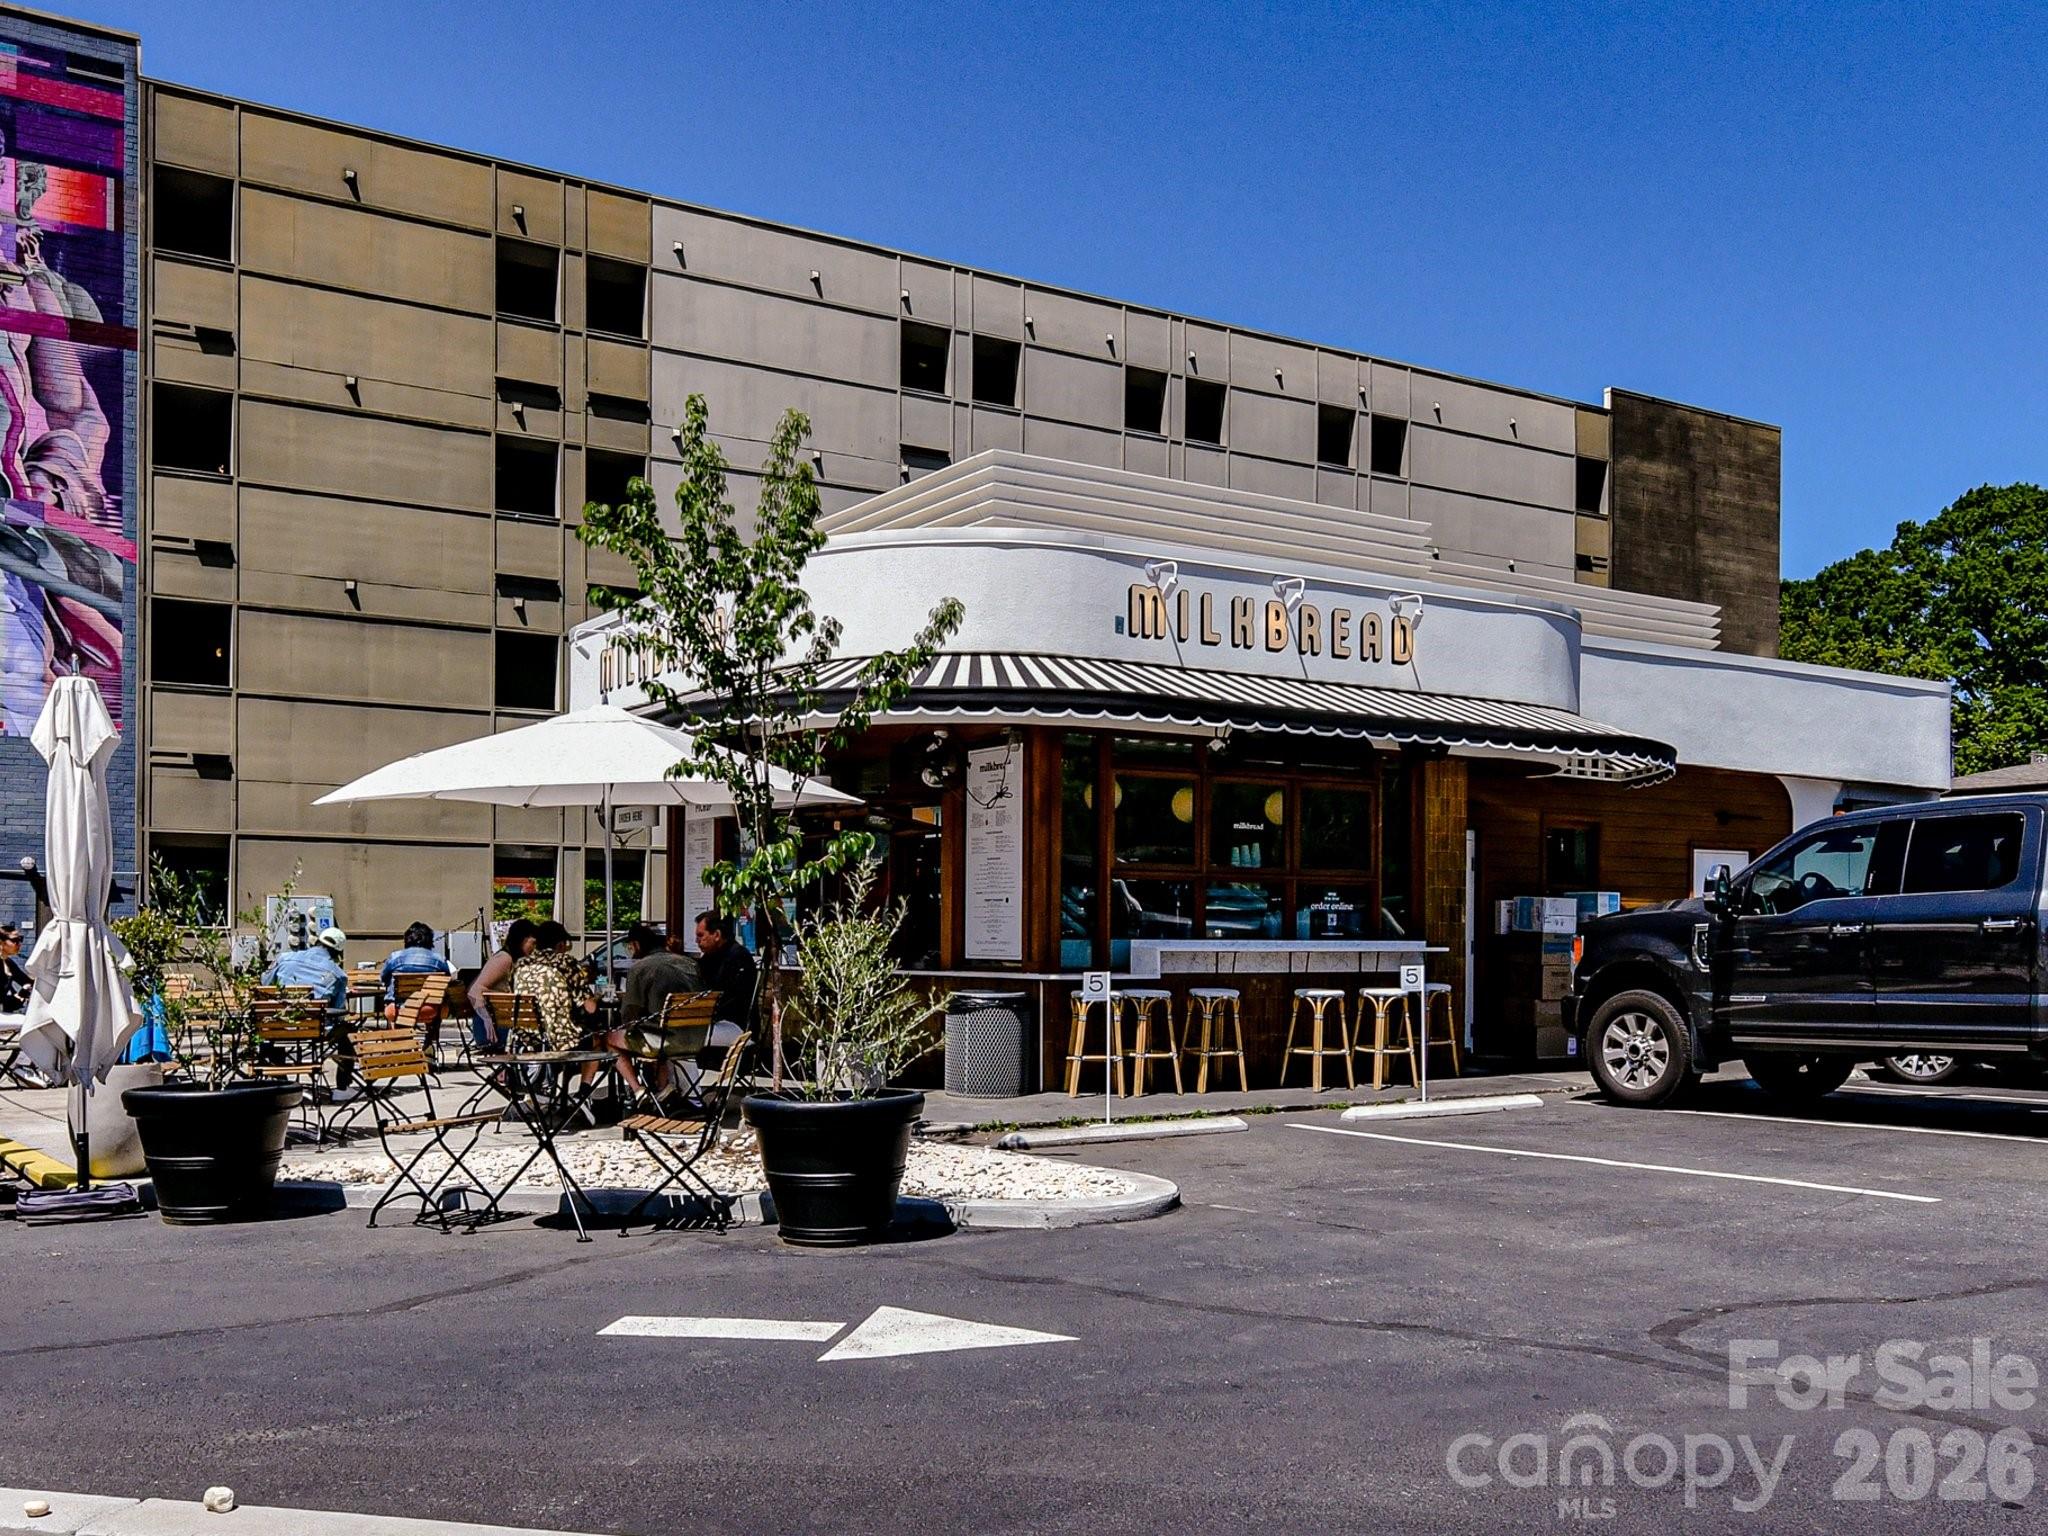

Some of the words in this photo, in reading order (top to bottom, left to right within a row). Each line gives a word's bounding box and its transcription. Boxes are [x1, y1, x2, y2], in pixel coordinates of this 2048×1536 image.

[1128, 583, 1415, 666] MILKBREAD
[1310, 901, 1330, 911] order
[1331, 901, 1354, 911] online
[1089, 974, 1104, 992] 5
[1405, 968, 1419, 985] 5
